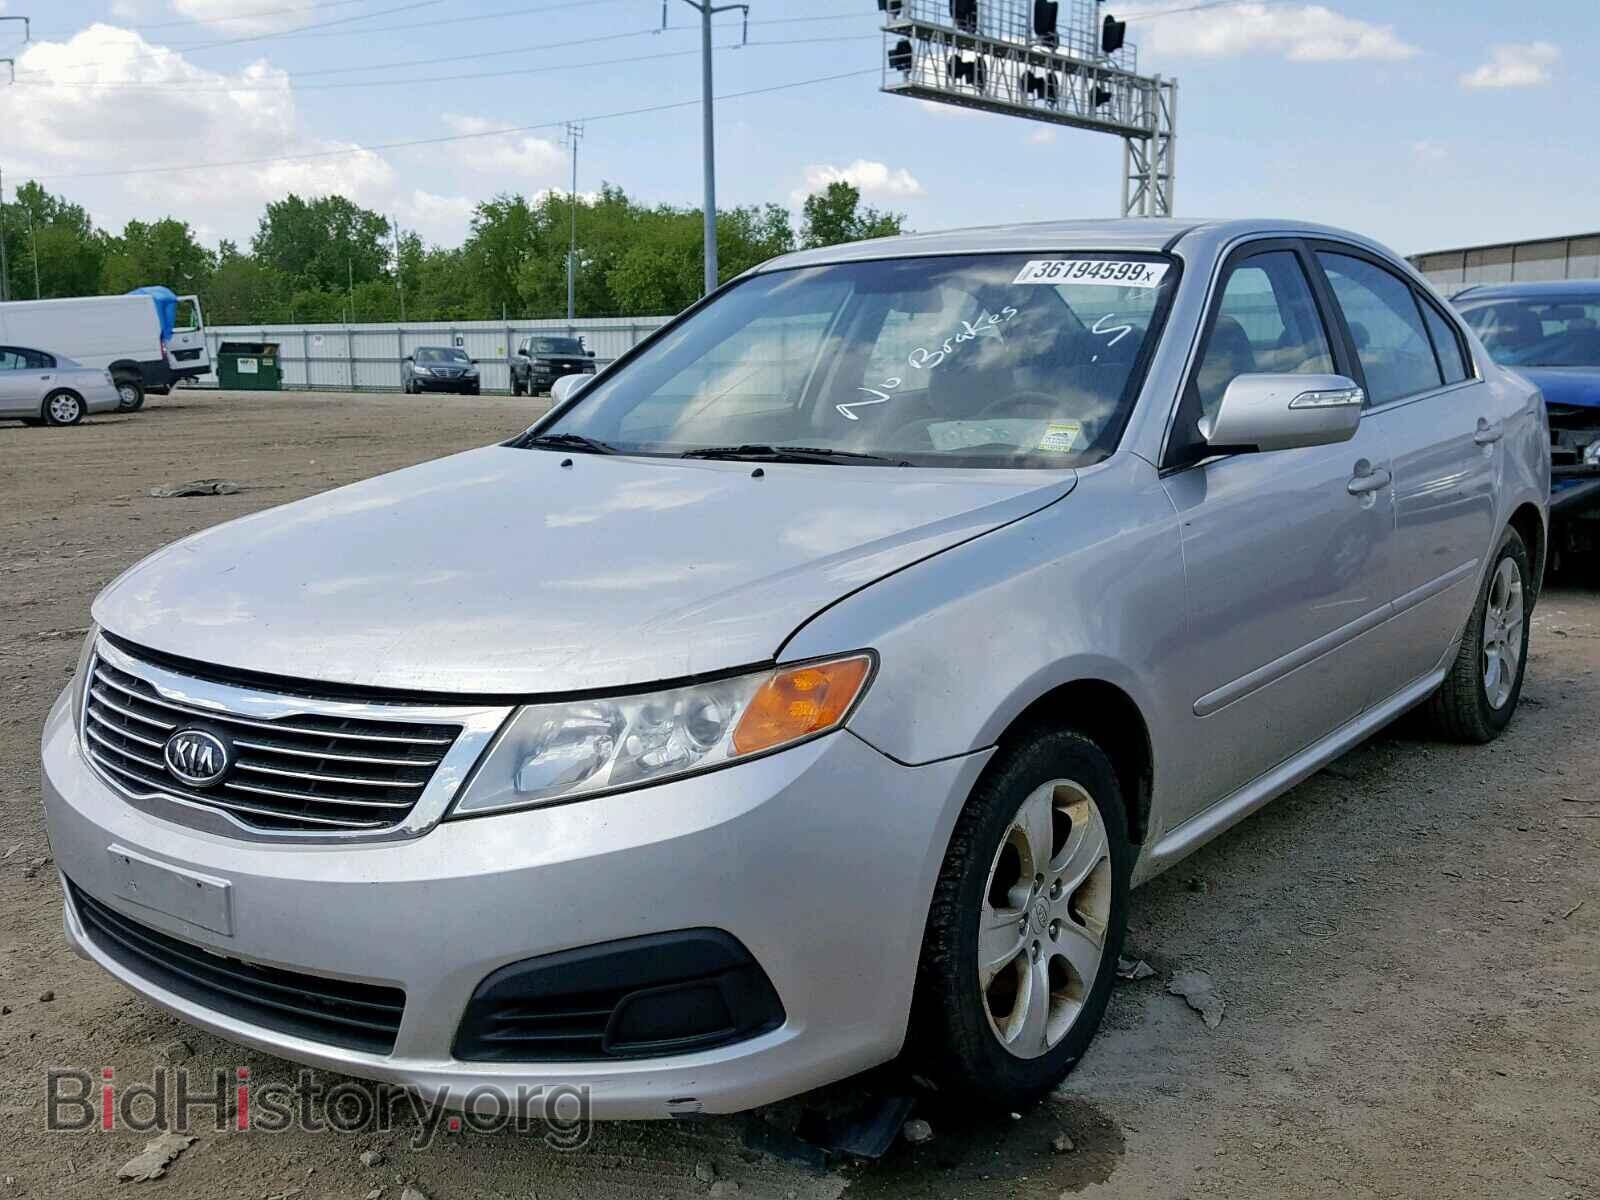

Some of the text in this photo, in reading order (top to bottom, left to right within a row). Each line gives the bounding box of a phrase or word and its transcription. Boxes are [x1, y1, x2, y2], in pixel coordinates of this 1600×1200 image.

[835, 305, 1018, 421] No Brakes
[173, 738, 215, 774] KIA
